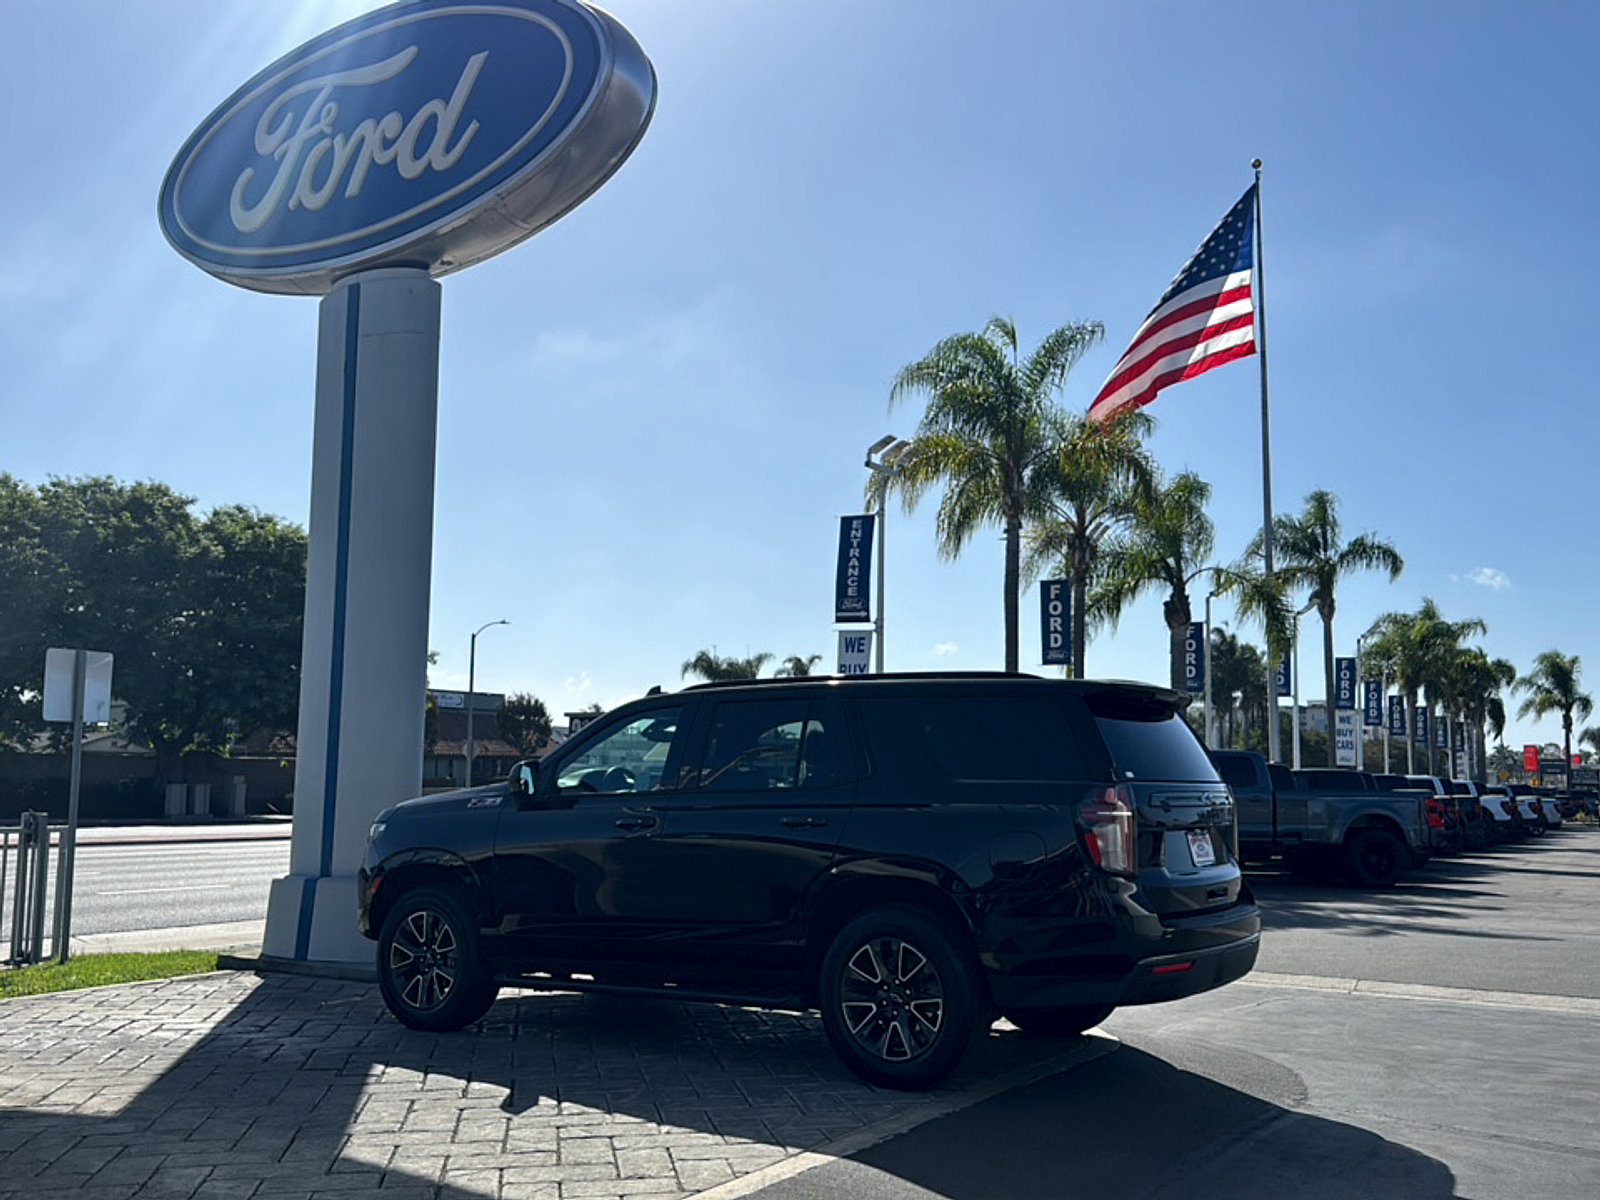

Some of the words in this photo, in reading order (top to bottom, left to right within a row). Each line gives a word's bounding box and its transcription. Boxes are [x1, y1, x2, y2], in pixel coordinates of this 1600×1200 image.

[229, 45, 489, 234] Ford
[847, 520, 863, 596] ENTRANCE
[1048, 585, 1063, 648] FORD
[845, 636, 866, 653] WE
[1185, 626, 1197, 678] FORD
[1340, 660, 1350, 699] FORD
[1368, 684, 1378, 717] FORD
[1336, 728, 1354, 737] BUY
[1339, 716, 1352, 724] WE
[1336, 740, 1354, 750] CARS
